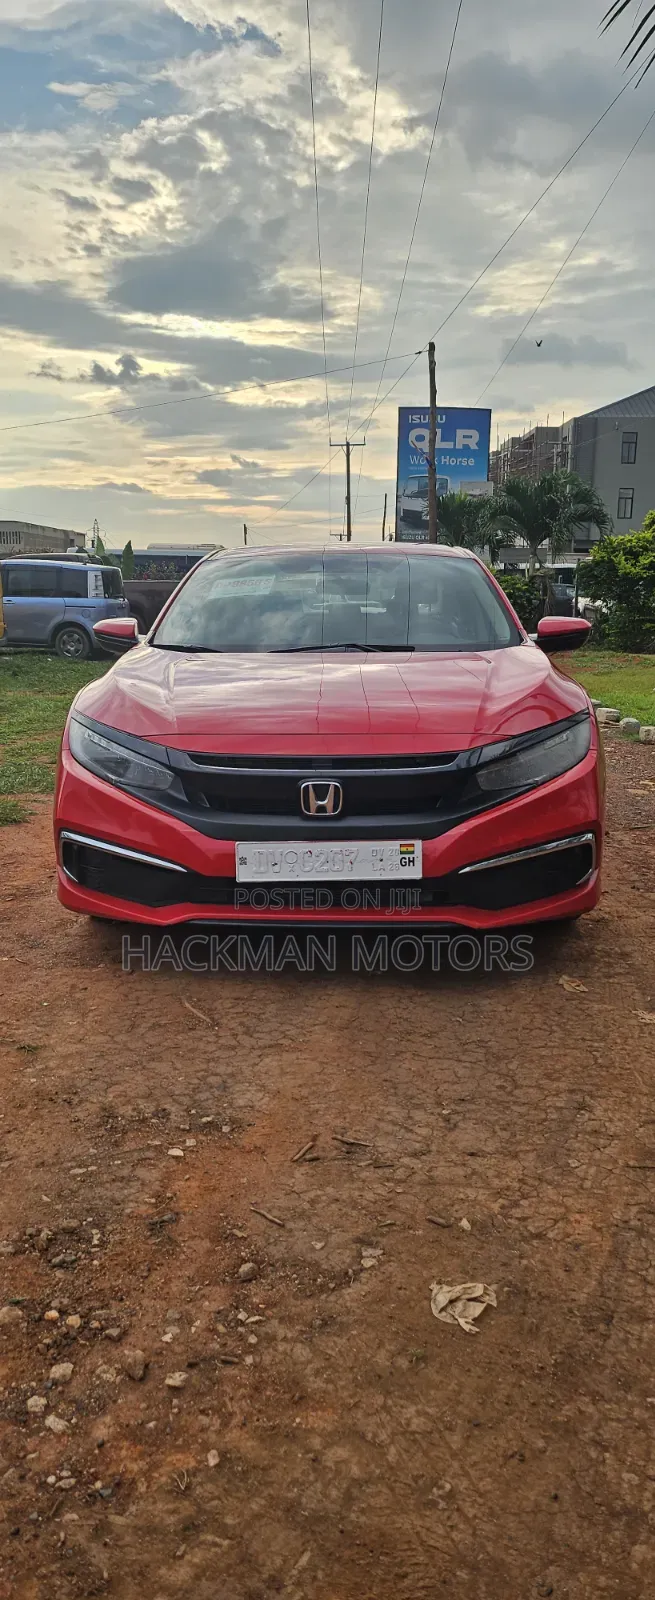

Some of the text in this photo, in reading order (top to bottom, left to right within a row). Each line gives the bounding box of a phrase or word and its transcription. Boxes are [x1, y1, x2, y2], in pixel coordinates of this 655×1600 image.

[408, 414, 446, 423] ISUU
[408, 428, 480, 452] QLR
[409, 455, 475, 465] Wok Horse
[400, 857, 415, 867] GH
